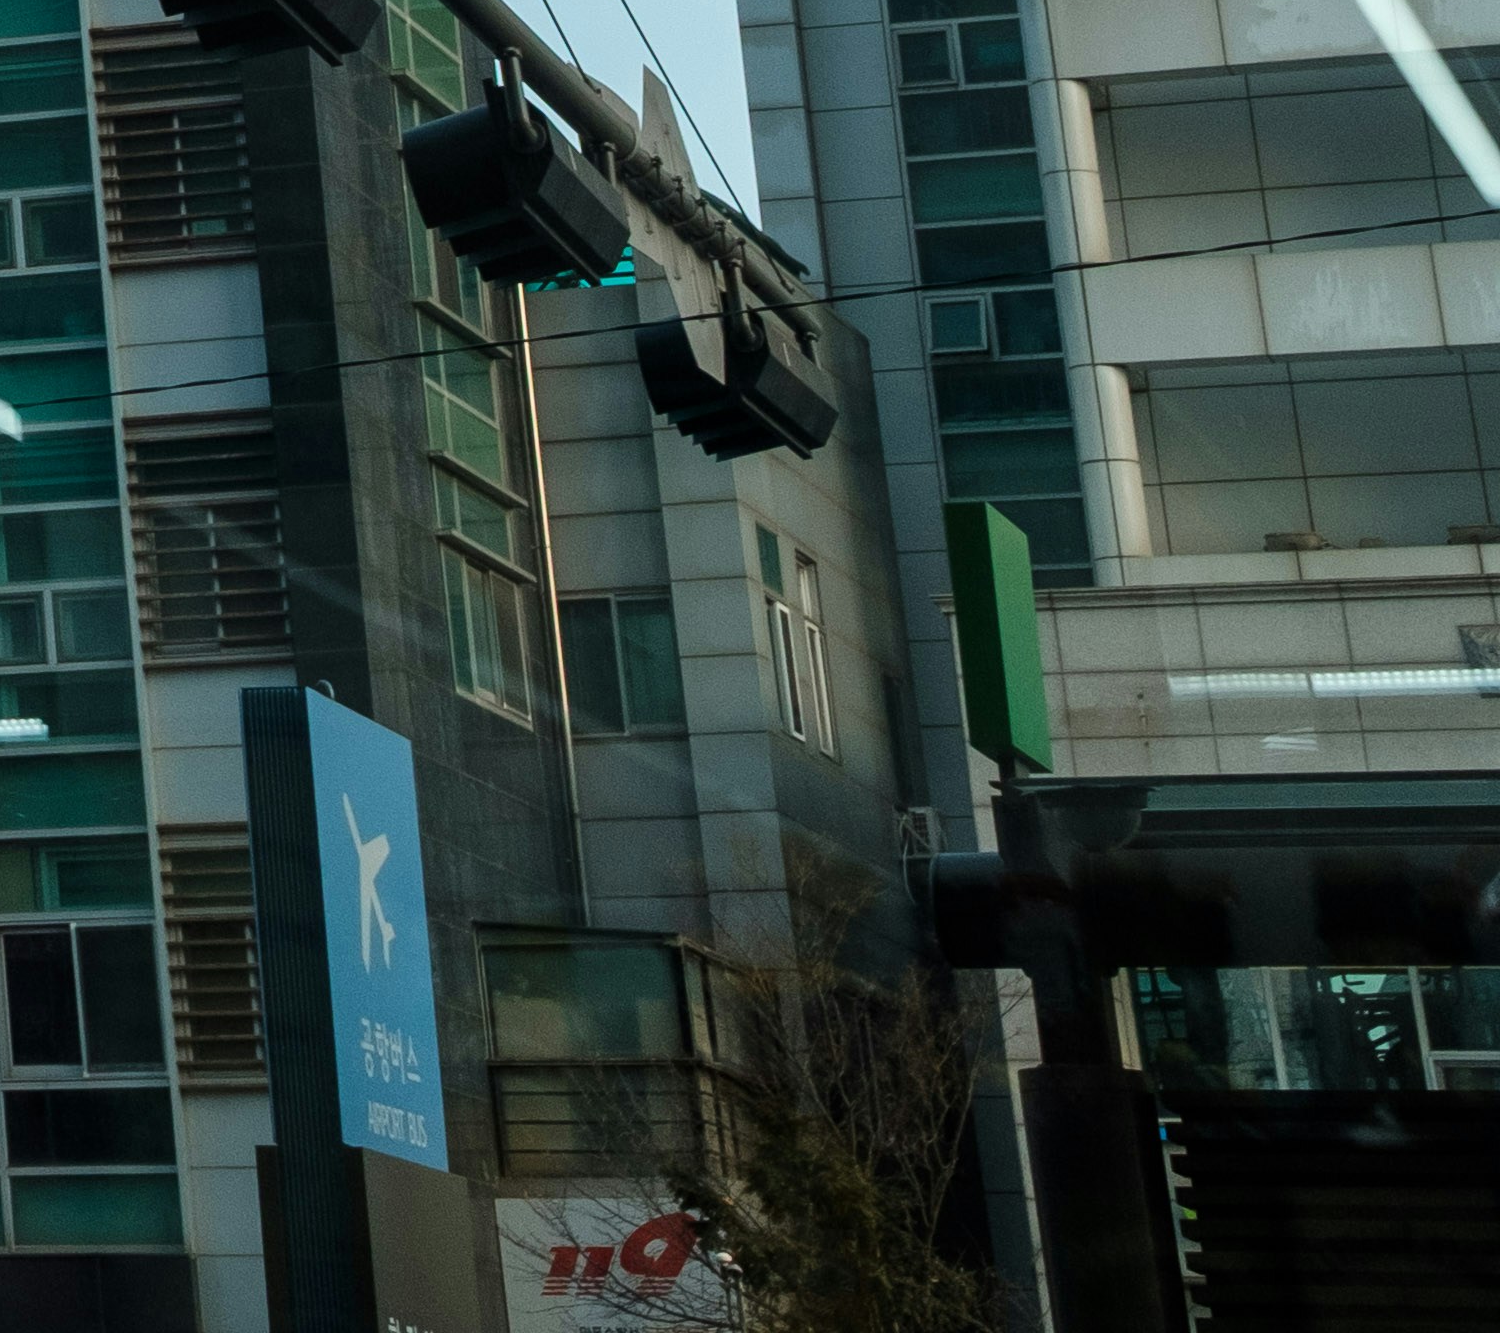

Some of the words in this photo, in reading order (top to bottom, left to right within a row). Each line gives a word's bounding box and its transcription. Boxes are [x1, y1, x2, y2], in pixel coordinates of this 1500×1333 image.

[360, 1016, 422, 1085] 공항버스
[367, 1100, 406, 1142] AIRPORT
[406, 1111, 429, 1149] BUS
[541, 1211, 698, 1296] 119
